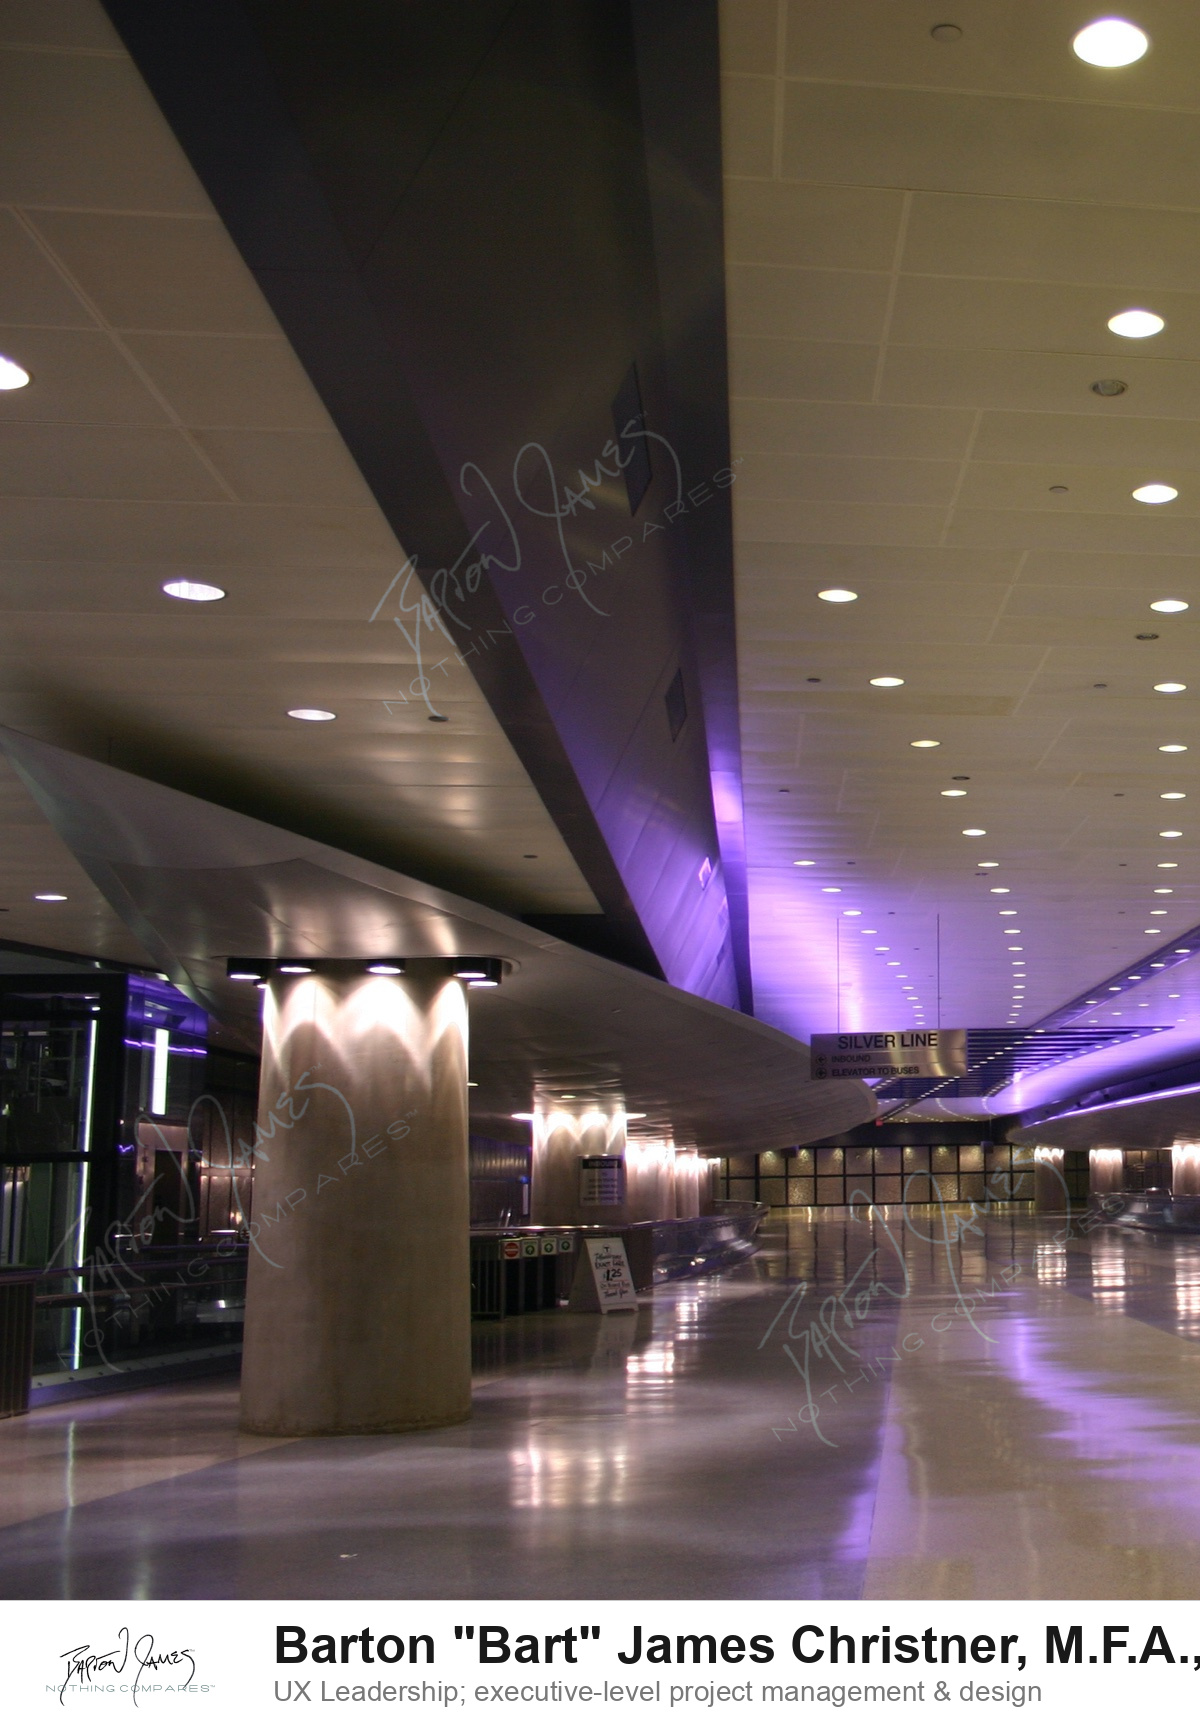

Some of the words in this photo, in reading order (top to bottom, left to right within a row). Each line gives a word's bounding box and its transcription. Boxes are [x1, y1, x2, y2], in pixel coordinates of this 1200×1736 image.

[837, 1034, 896, 1050] SILVER
[901, 1033, 938, 1048] LINE
[831, 1054, 871, 1063] INBOUND
[831, 1068, 876, 1077] ELEVATOR
[877, 1067, 890, 1075] TO
[890, 1066, 920, 1075] BUSES
